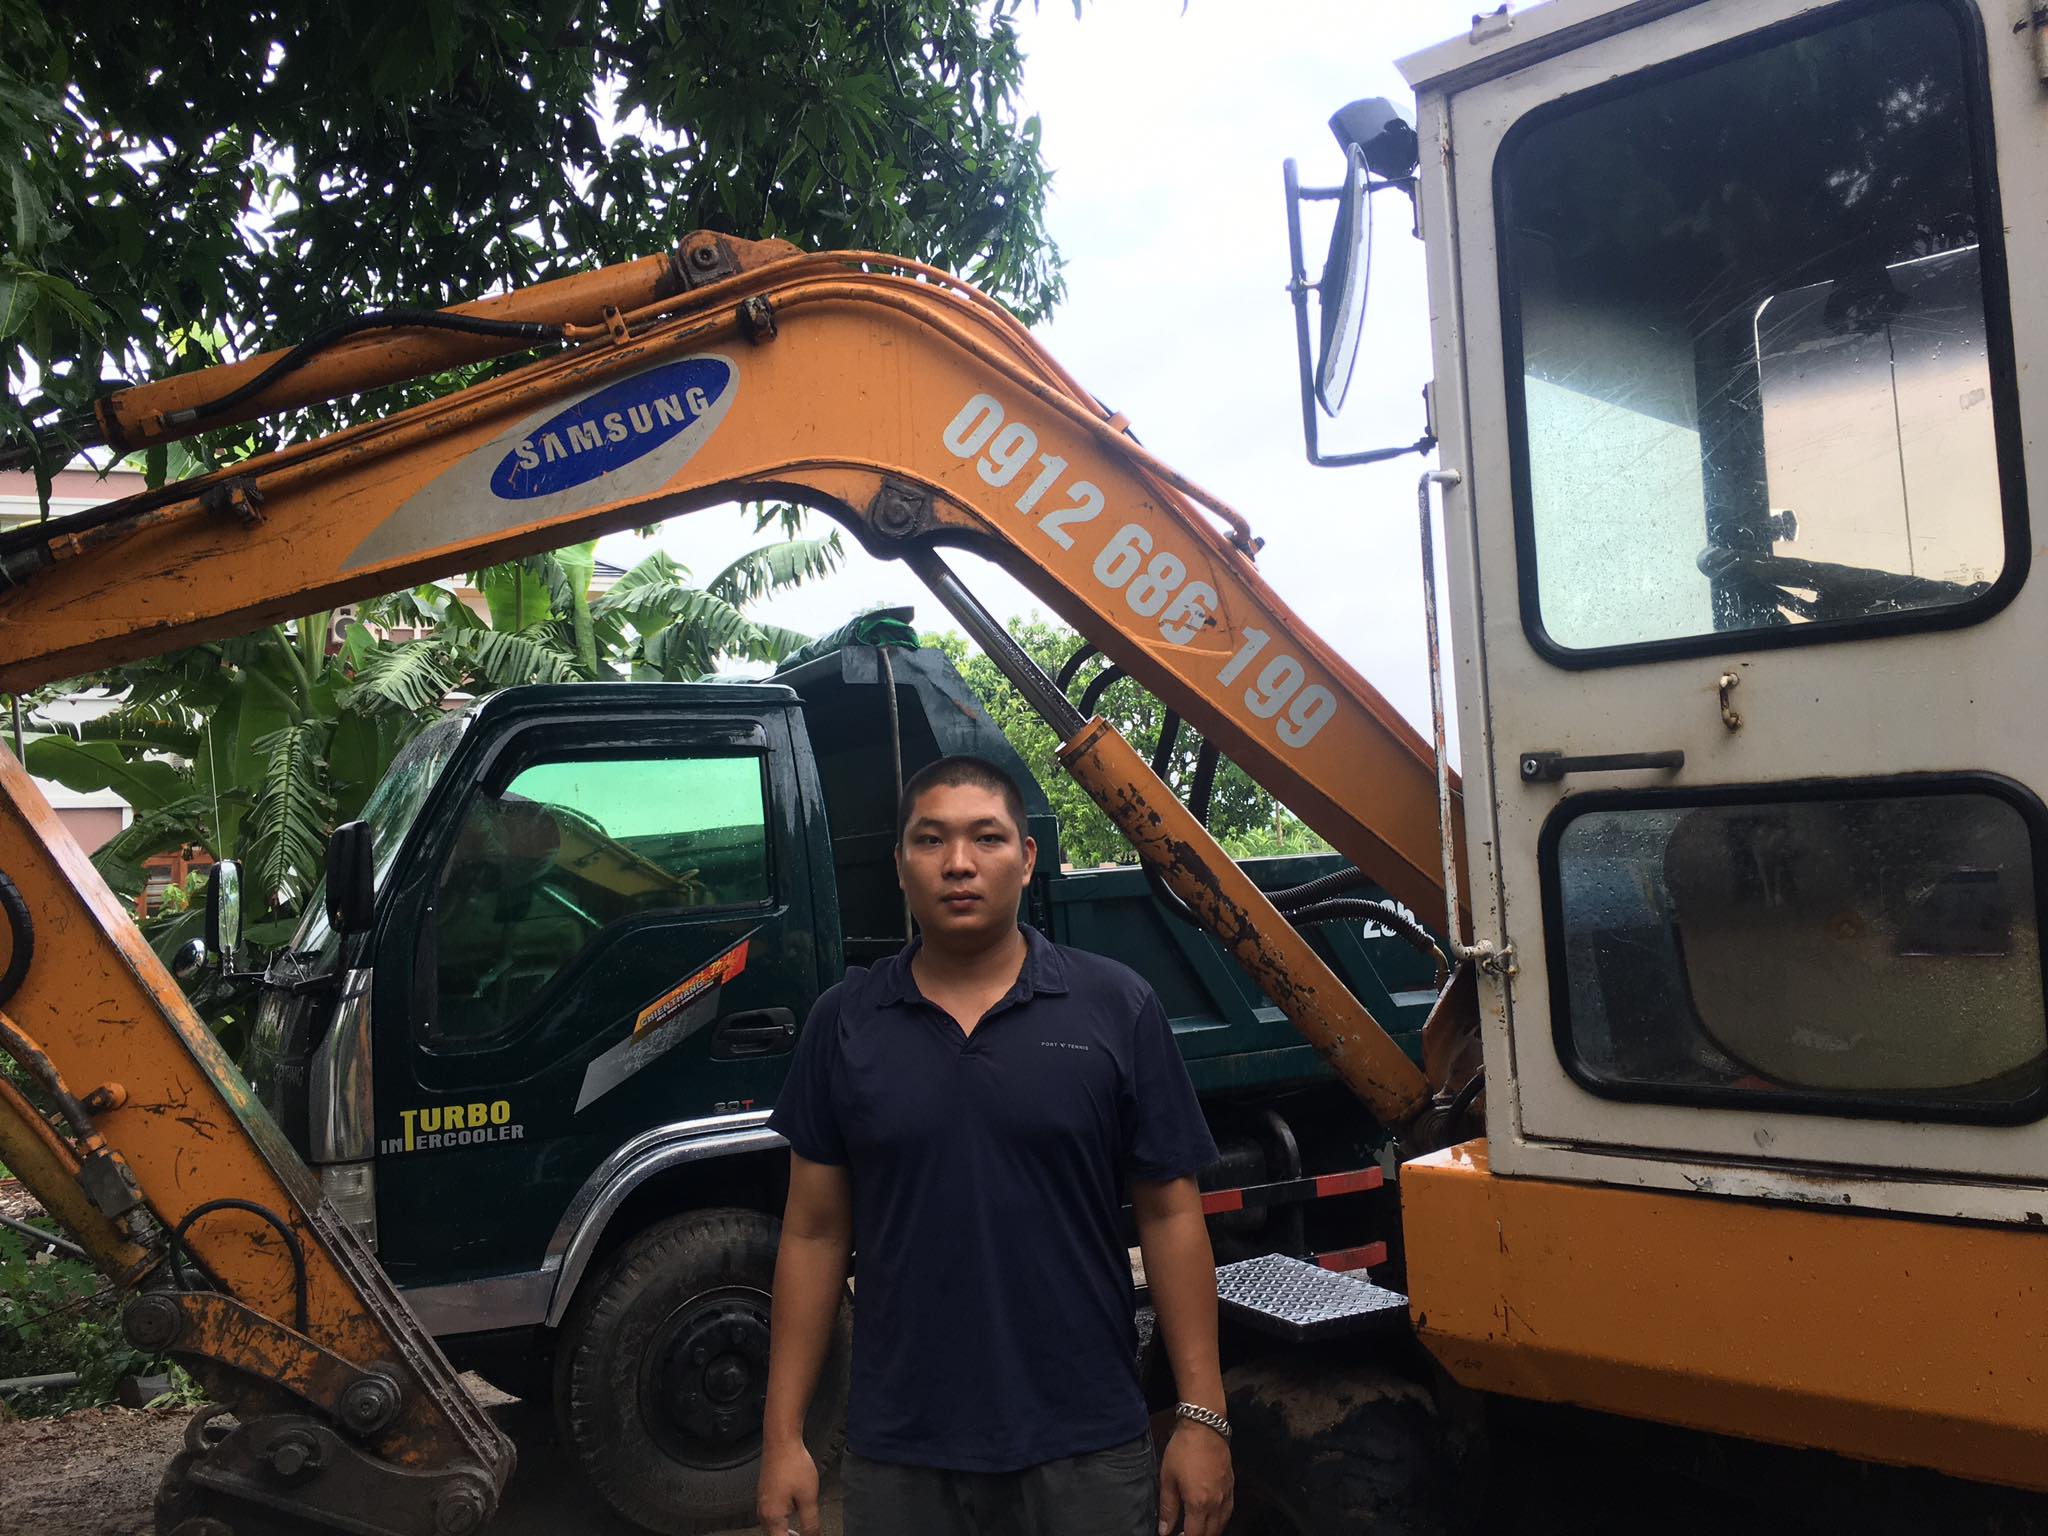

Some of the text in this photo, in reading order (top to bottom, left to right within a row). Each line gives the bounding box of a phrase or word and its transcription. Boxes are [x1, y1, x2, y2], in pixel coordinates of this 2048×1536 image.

[514, 387, 708, 470] SAMSUNG
[942, 393, 1338, 749] 0912 686 199
[381, 1124, 525, 1155] INTERCOOLER
[400, 1100, 511, 1151] TURBO
